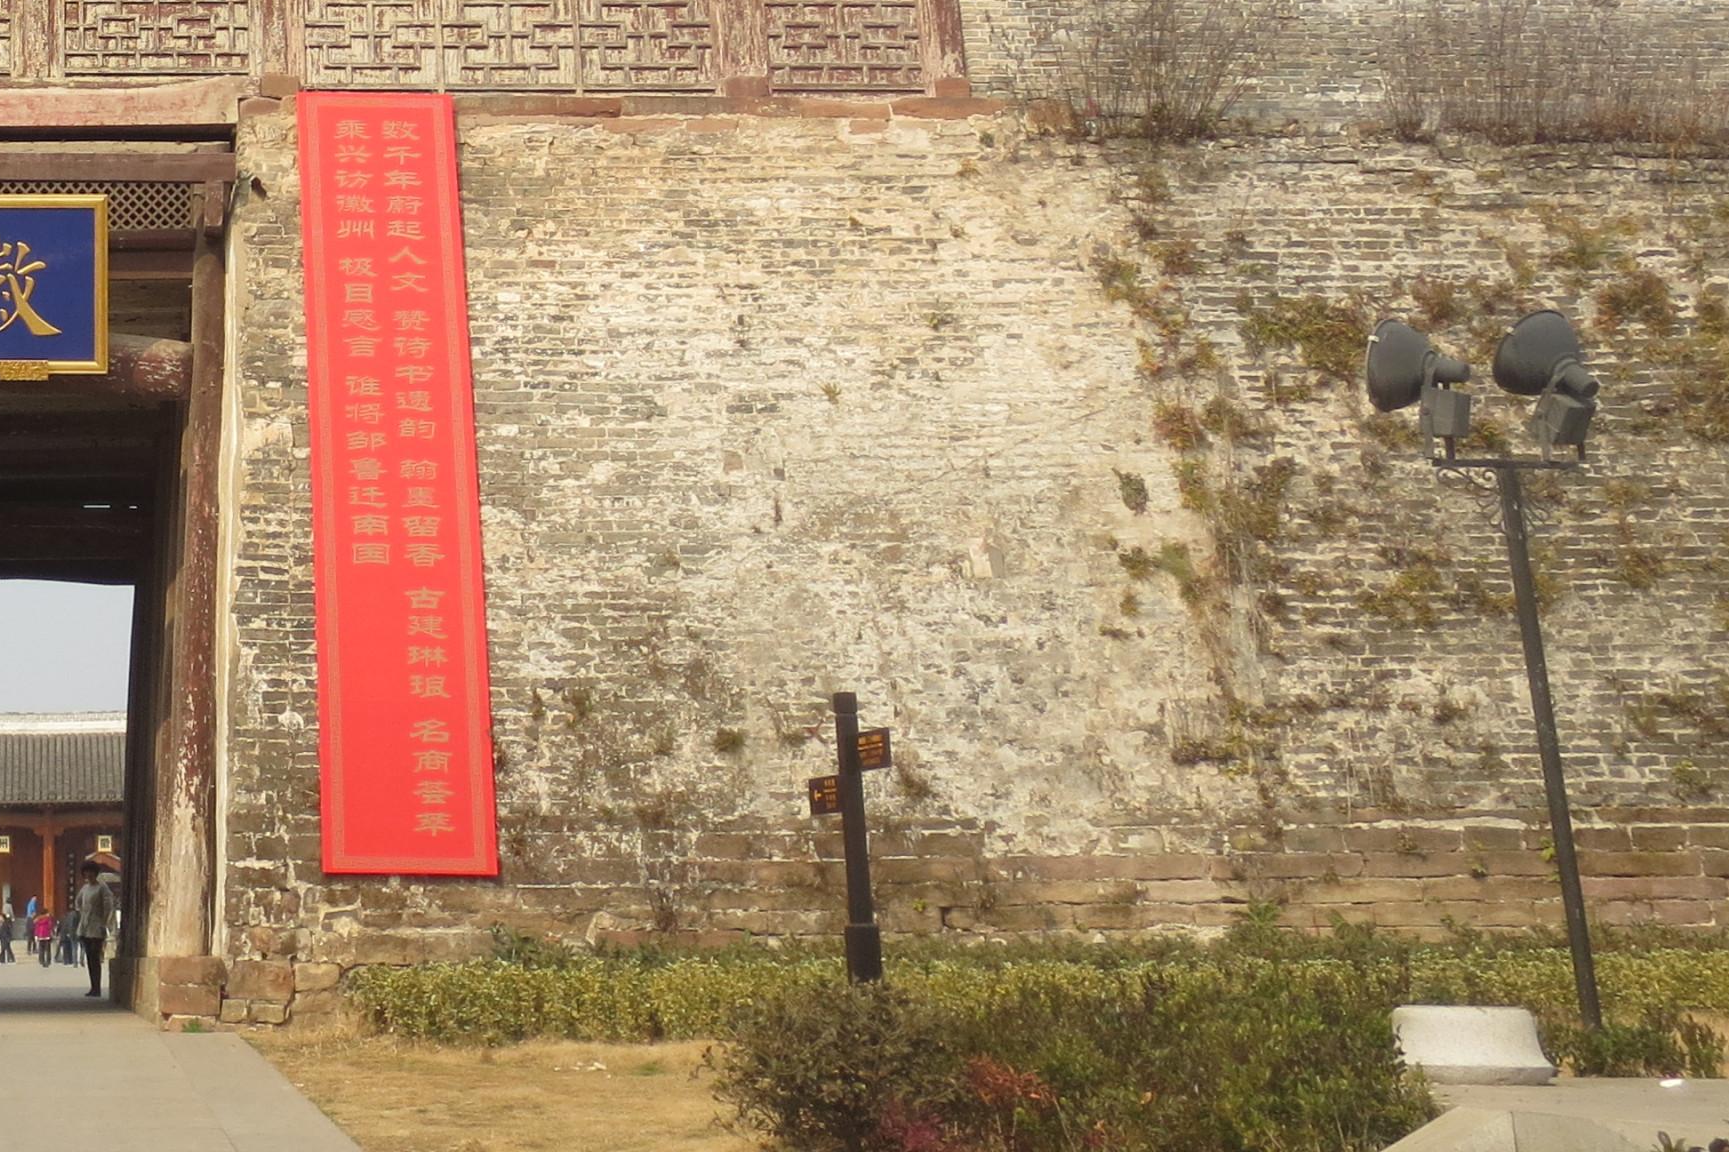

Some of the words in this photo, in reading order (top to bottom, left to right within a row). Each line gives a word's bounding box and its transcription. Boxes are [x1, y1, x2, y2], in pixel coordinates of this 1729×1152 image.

[333, 119, 377, 240] 乘兴访徽州
[382, 119, 430, 294] 数千年蔚起人文
[344, 375, 391, 566] 谁将邹鲁迁南国
[400, 458, 446, 568] 翰墨留香
[403, 586, 452, 700] 古建琳琅
[409, 718, 455, 838] 名商荟萃
